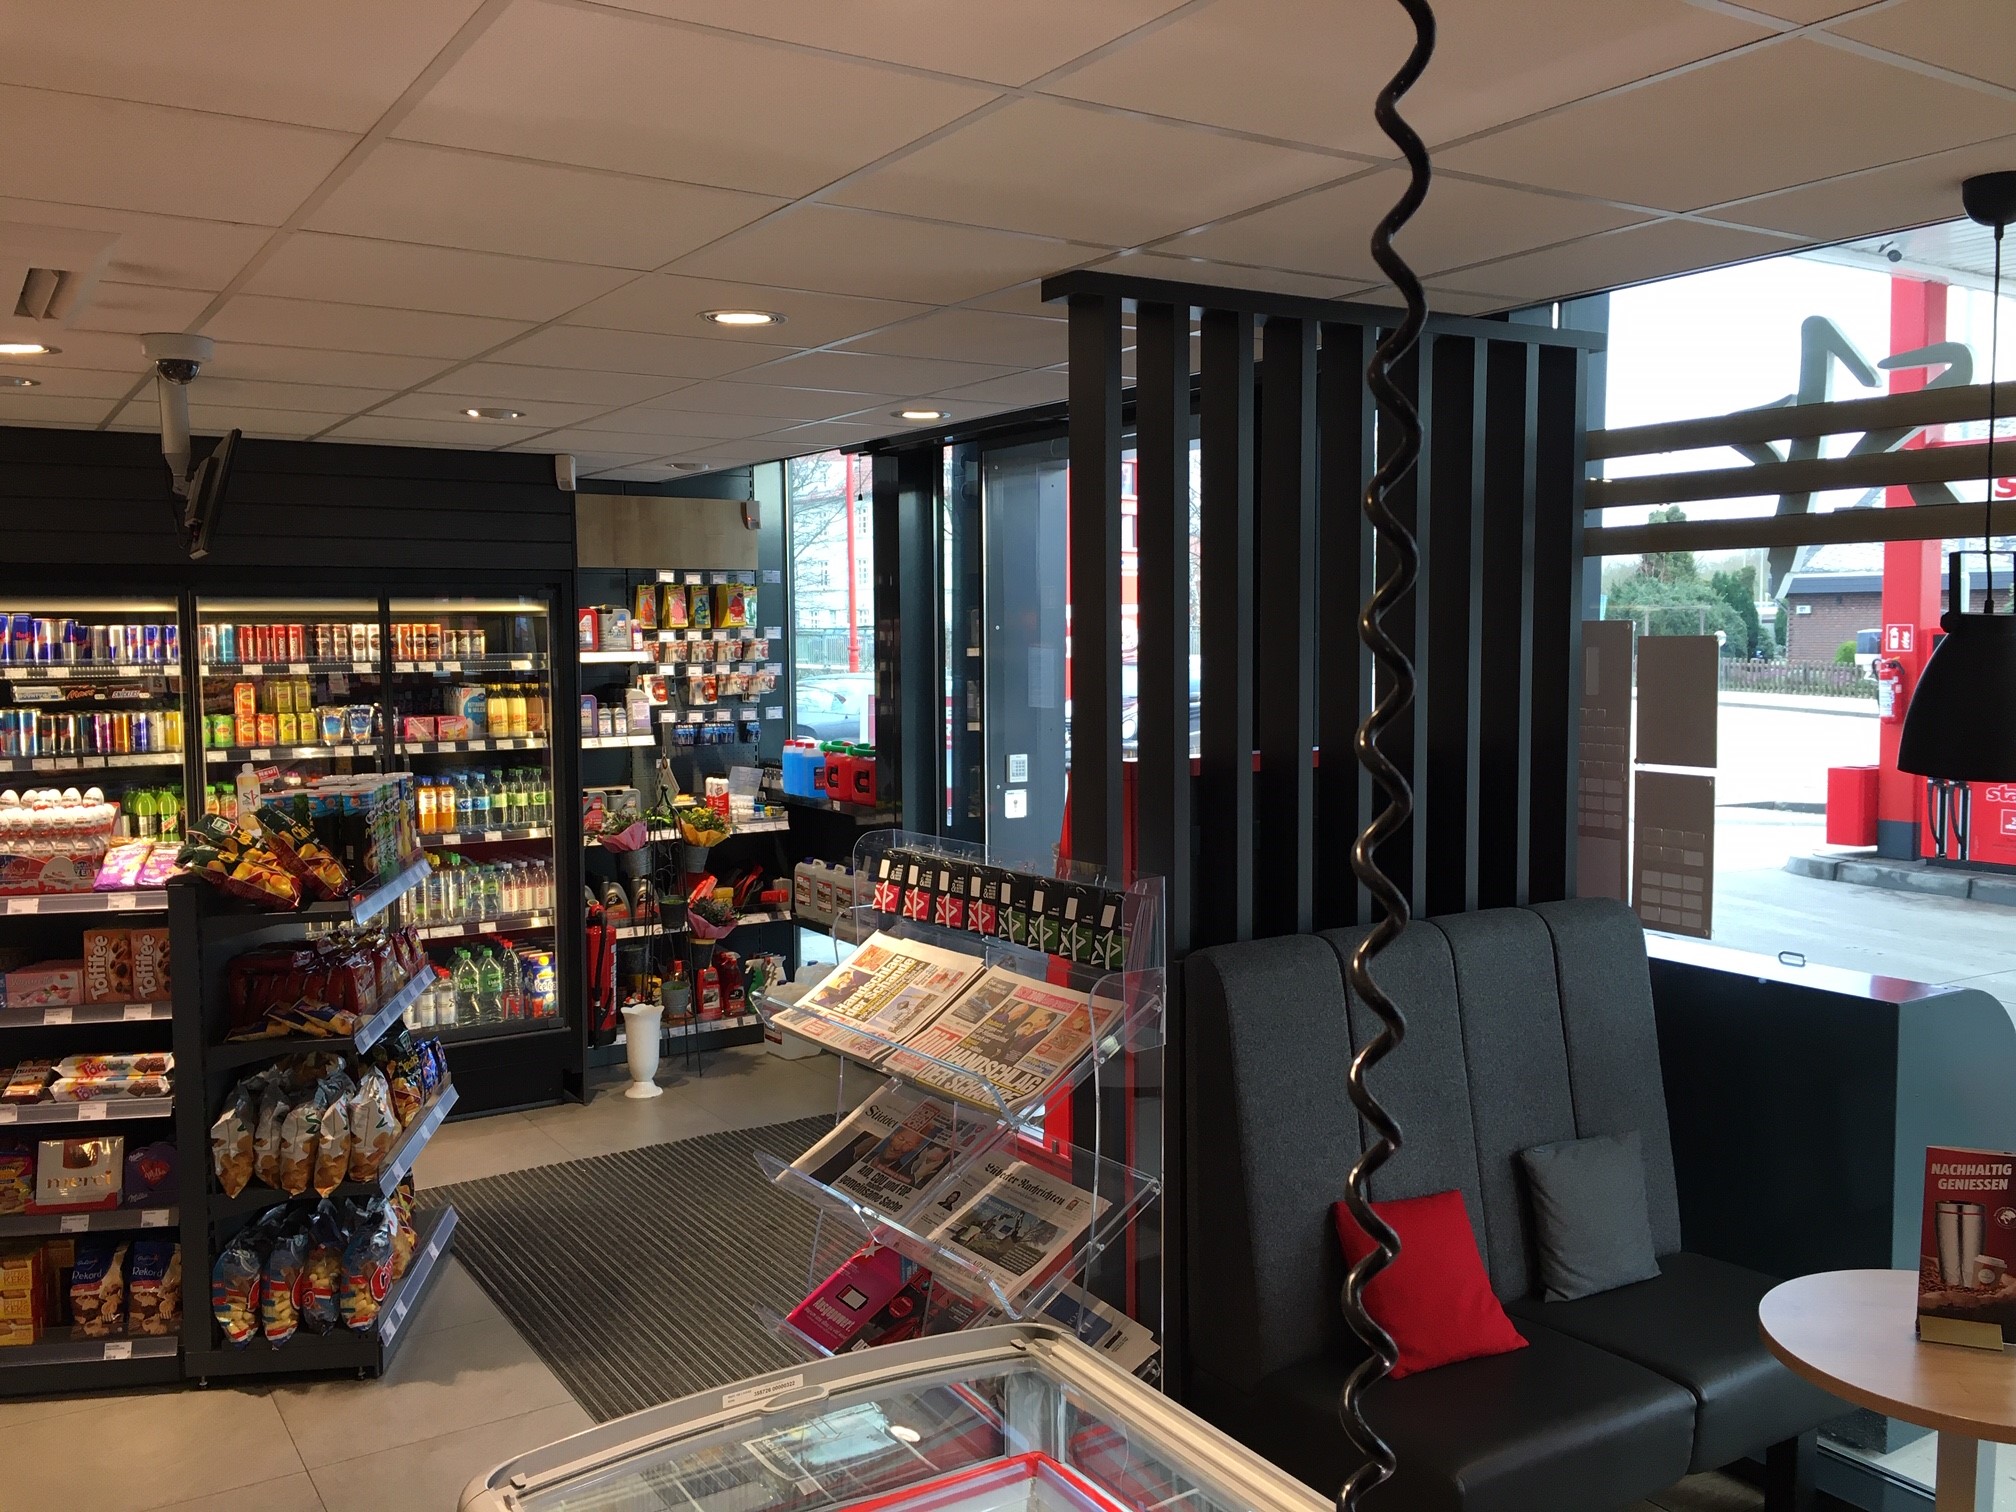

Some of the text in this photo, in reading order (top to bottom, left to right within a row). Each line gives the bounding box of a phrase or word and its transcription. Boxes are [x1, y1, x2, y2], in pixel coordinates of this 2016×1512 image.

[88, 935, 109, 1000] Toffifee
[135, 934, 157, 999] Toffifee
[917, 1063, 954, 1087] DER
[940, 1046, 1042, 1094] HANDSCHLAG
[1931, 1163, 2012, 1176] NACHHALTIG
[47, 1171, 112, 1189] merci
[1938, 1178, 2009, 1191] GENIESSEN
[879, 1196, 903, 1213] Sache
[72, 1269, 102, 1280] Rekord
[132, 1266, 163, 1278] Rekord
